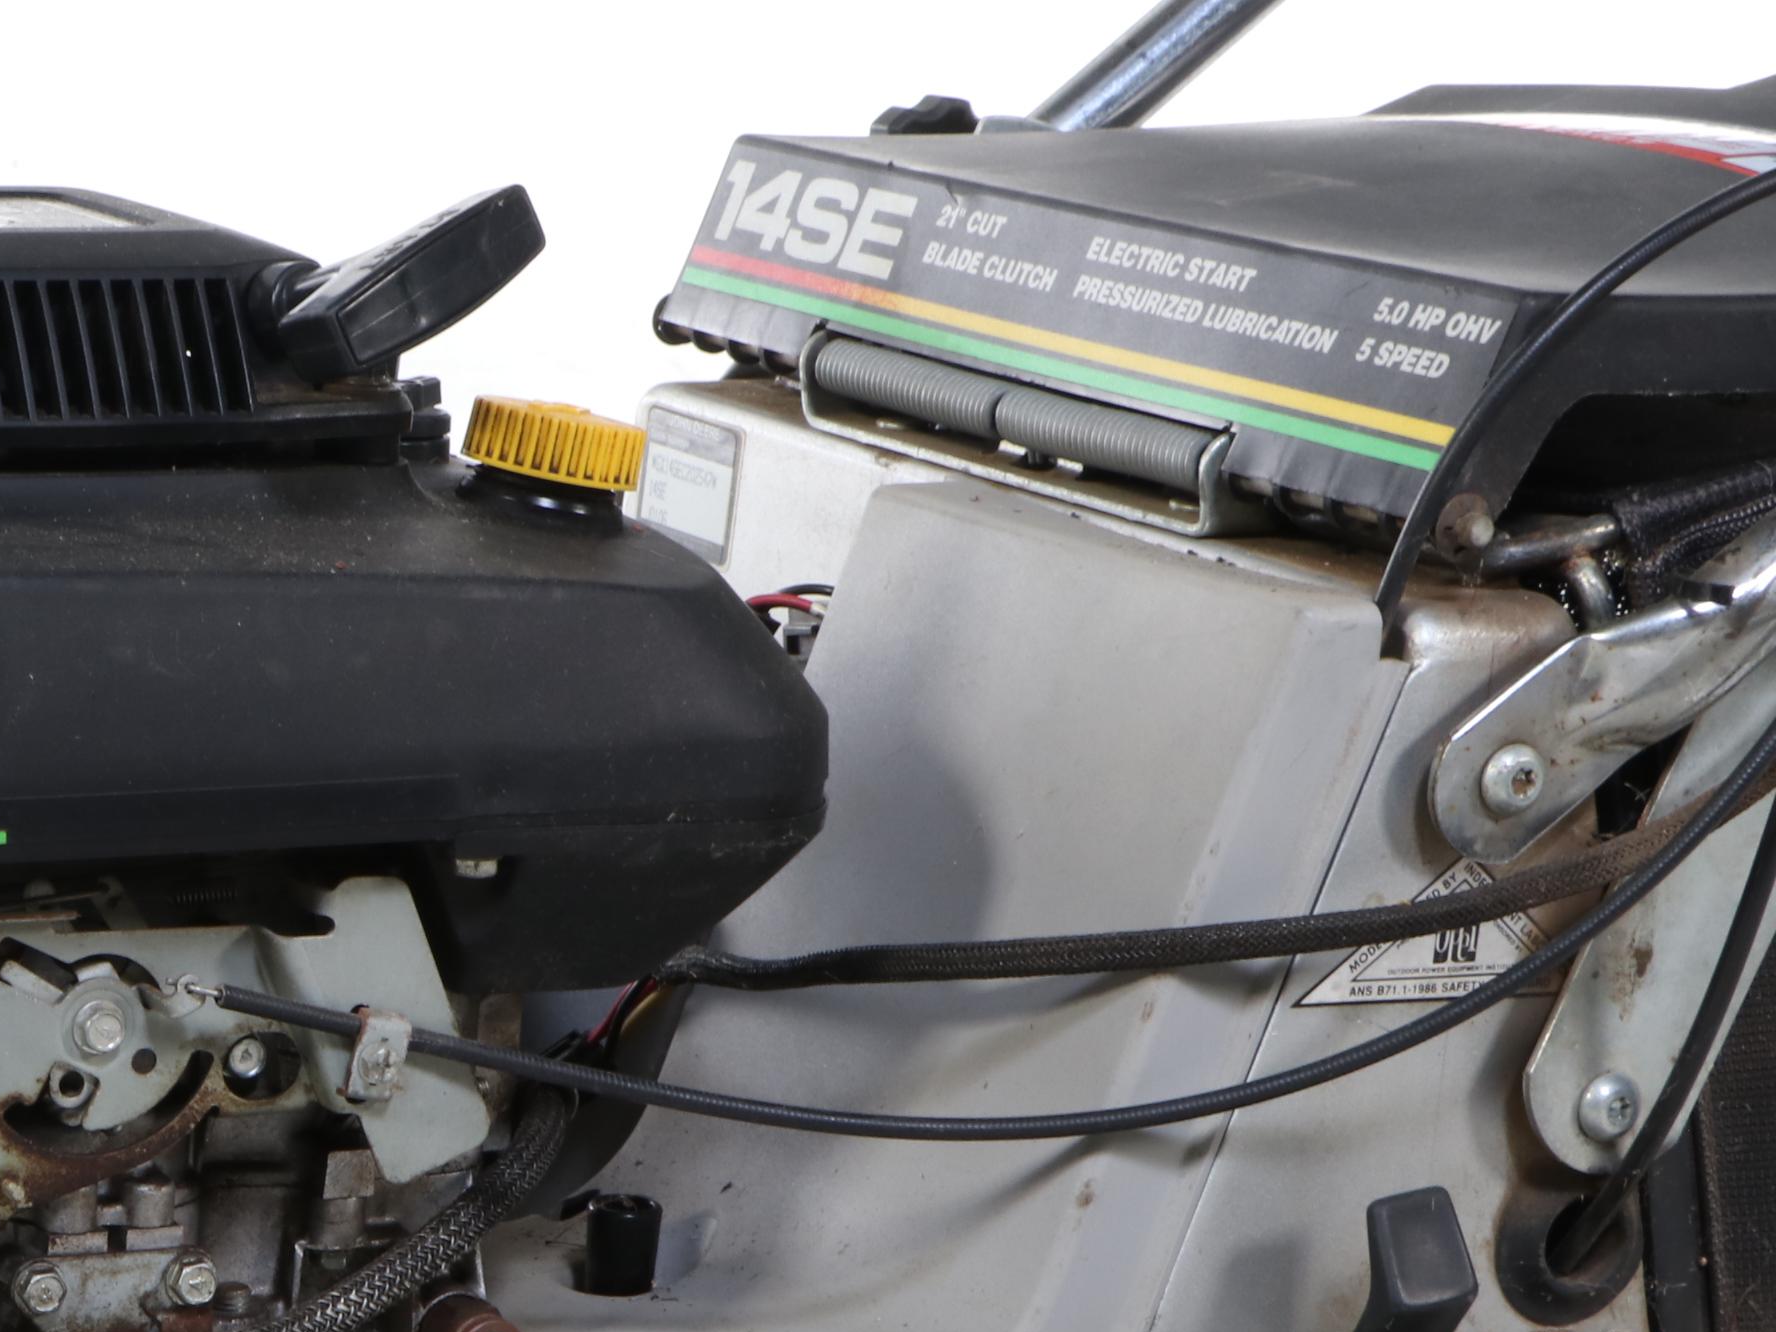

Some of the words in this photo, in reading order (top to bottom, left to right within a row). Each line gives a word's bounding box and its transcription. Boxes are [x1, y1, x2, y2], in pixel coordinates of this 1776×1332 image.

[714, 160, 918, 280] 14SE
[936, 204, 967, 228] 21"
[967, 210, 1007, 239] CUT
[923, 242, 981, 275] BLADE
[983, 254, 1058, 293] CLUTCH
[1086, 236, 1191, 280] ELECTRIC
[1184, 257, 1258, 293] START
[1072, 274, 1202, 325] PRESSURIZED
[1202, 299, 1339, 355] LUBRICATION
[1373, 297, 1409, 325] 5.0
[1409, 304, 1448, 334] HP
[1445, 312, 1502, 346] OHV
[1355, 338, 1374, 363] 5
[1373, 340, 1450, 380] SPEED
[1442, 872, 1458, 889] BY
[1348, 942, 1384, 973] MODE
[1349, 985, 1372, 997] ANS
[1377, 983, 1437, 996] B71.1-1986
